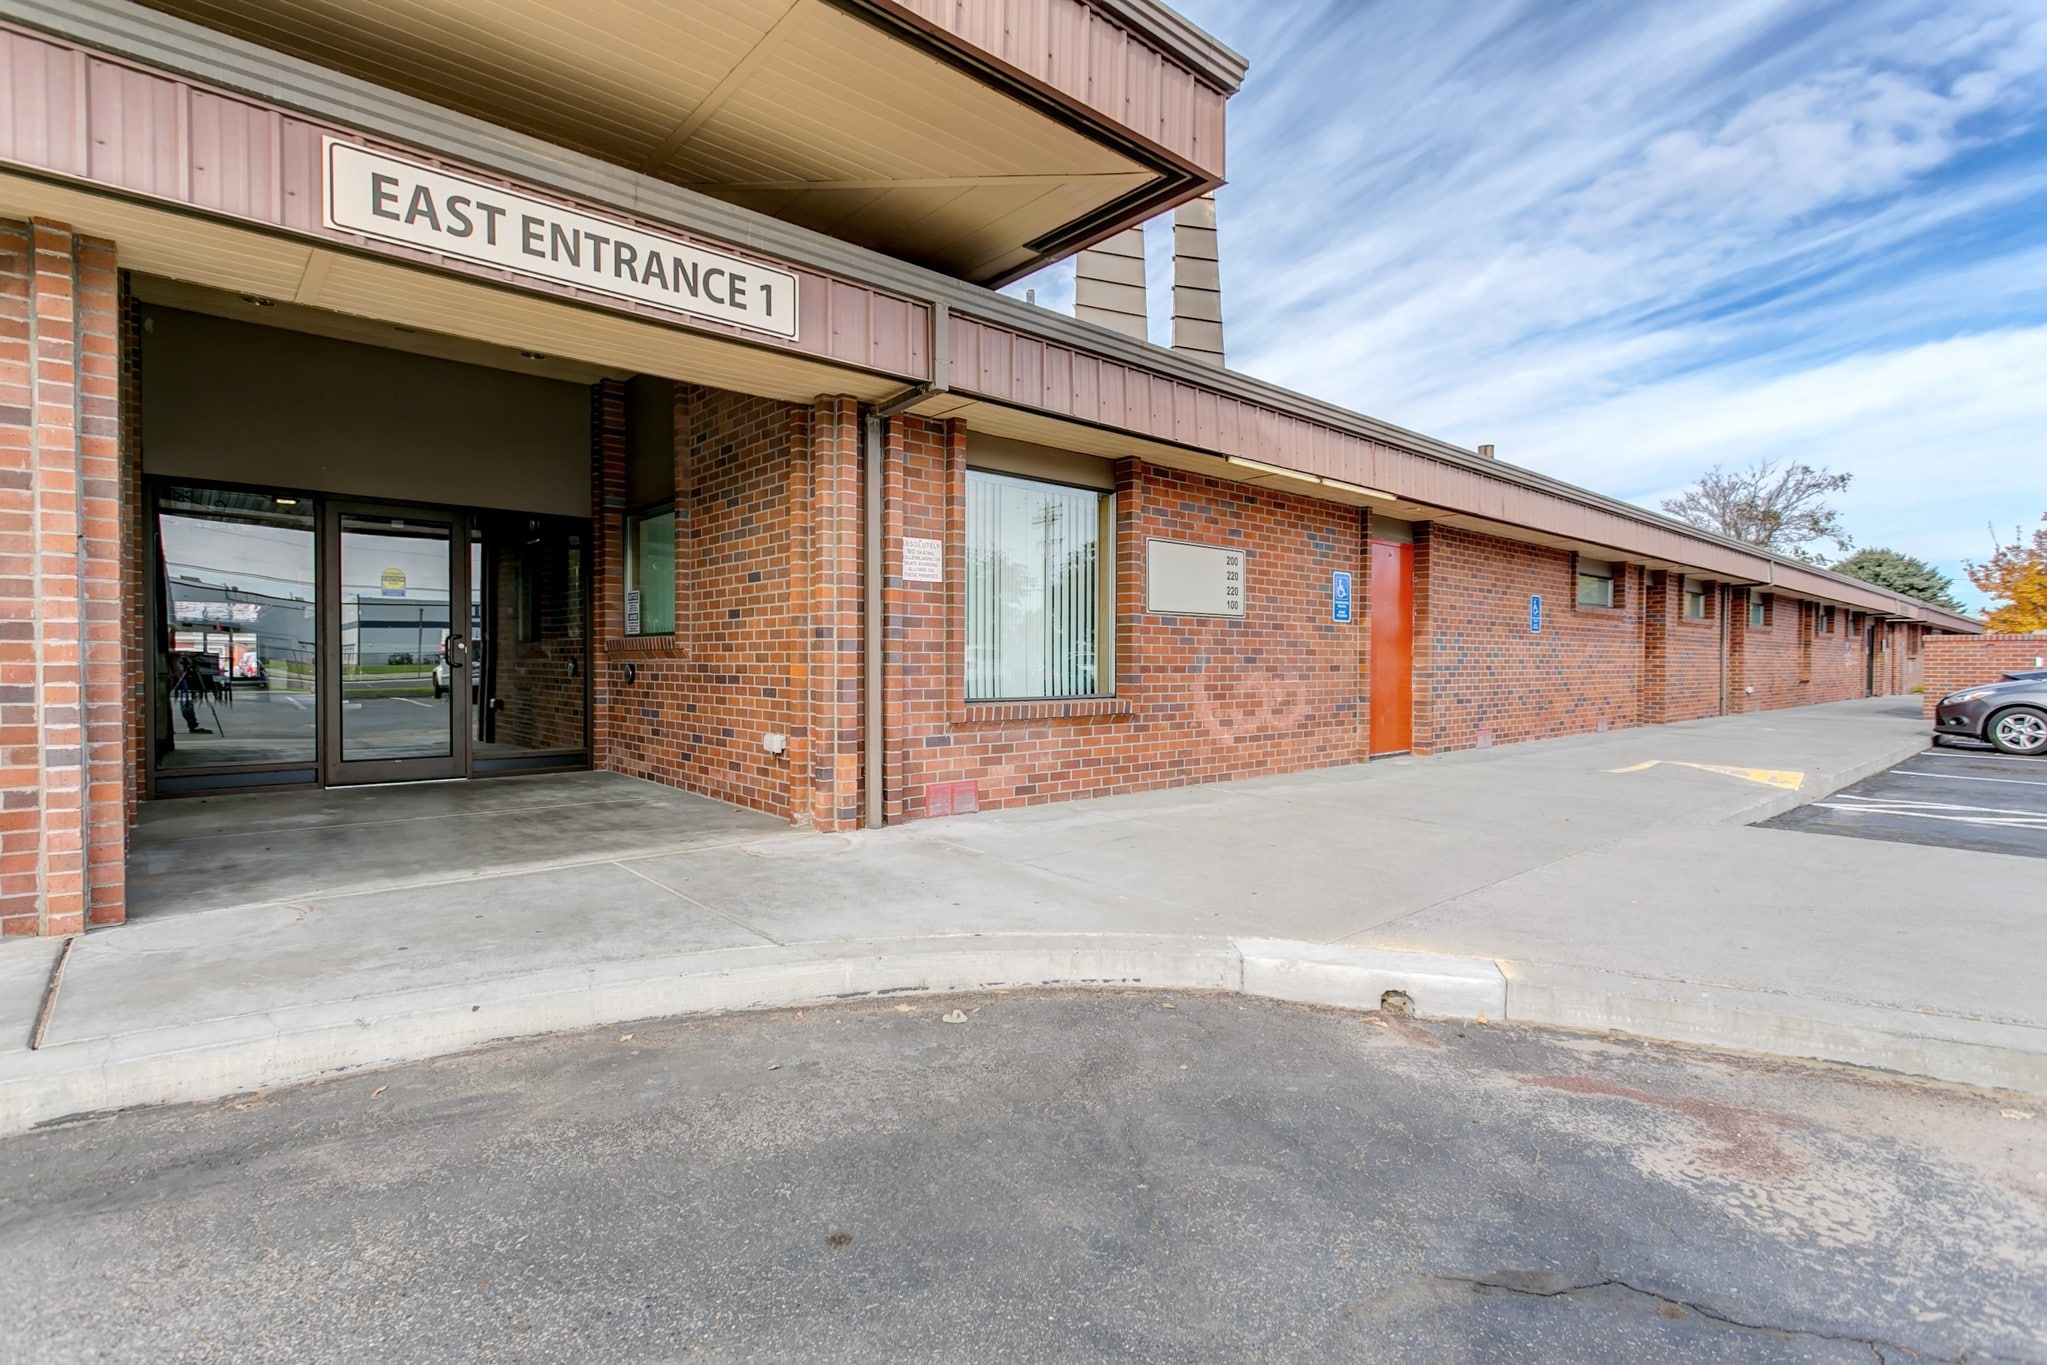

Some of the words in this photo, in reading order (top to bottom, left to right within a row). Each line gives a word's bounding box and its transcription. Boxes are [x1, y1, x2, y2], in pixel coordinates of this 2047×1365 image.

[372, 172, 506, 246] EAST
[522, 214, 747, 310] ENTRANCE
[760, 283, 772, 317] 1
[1226, 556, 1239, 566] 200
[1226, 571, 1239, 581] 220
[1226, 586, 1239, 596] 220
[1226, 600, 1239, 610] 100
